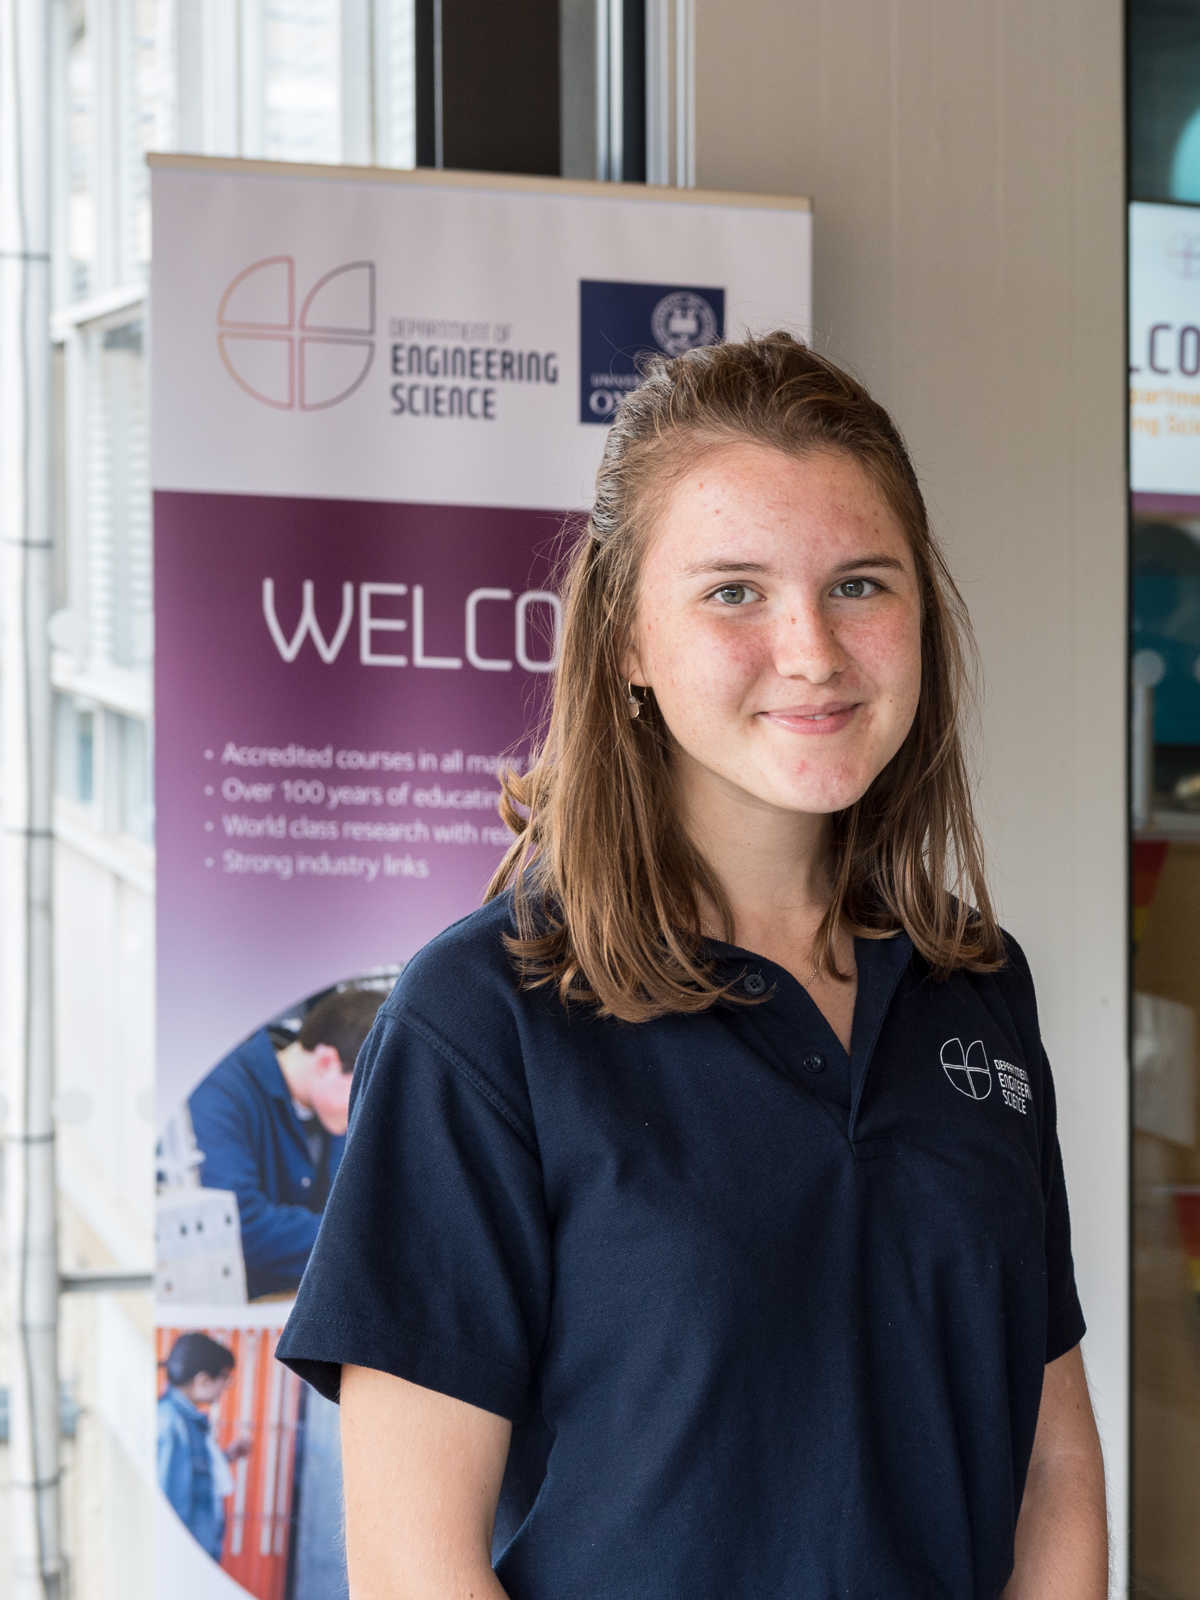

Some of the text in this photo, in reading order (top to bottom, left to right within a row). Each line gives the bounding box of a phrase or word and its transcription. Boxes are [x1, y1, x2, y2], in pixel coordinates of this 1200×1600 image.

[391, 342, 559, 384] ENGINEERING
[390, 382, 497, 420] SCIENCE
[222, 742, 334, 769] Accredited
[335, 750, 415, 772] courses
[417, 748, 439, 772] in
[440, 749, 464, 774] all
[222, 777, 276, 803] Over
[281, 779, 326, 805] 100
[327, 785, 384, 811] years
[385, 781, 410, 807] of
[222, 814, 287, 839] World
[289, 815, 340, 841] class
[342, 819, 430, 843] research
[431, 820, 479, 845] with
[223, 848, 430, 882] Strong industry links
